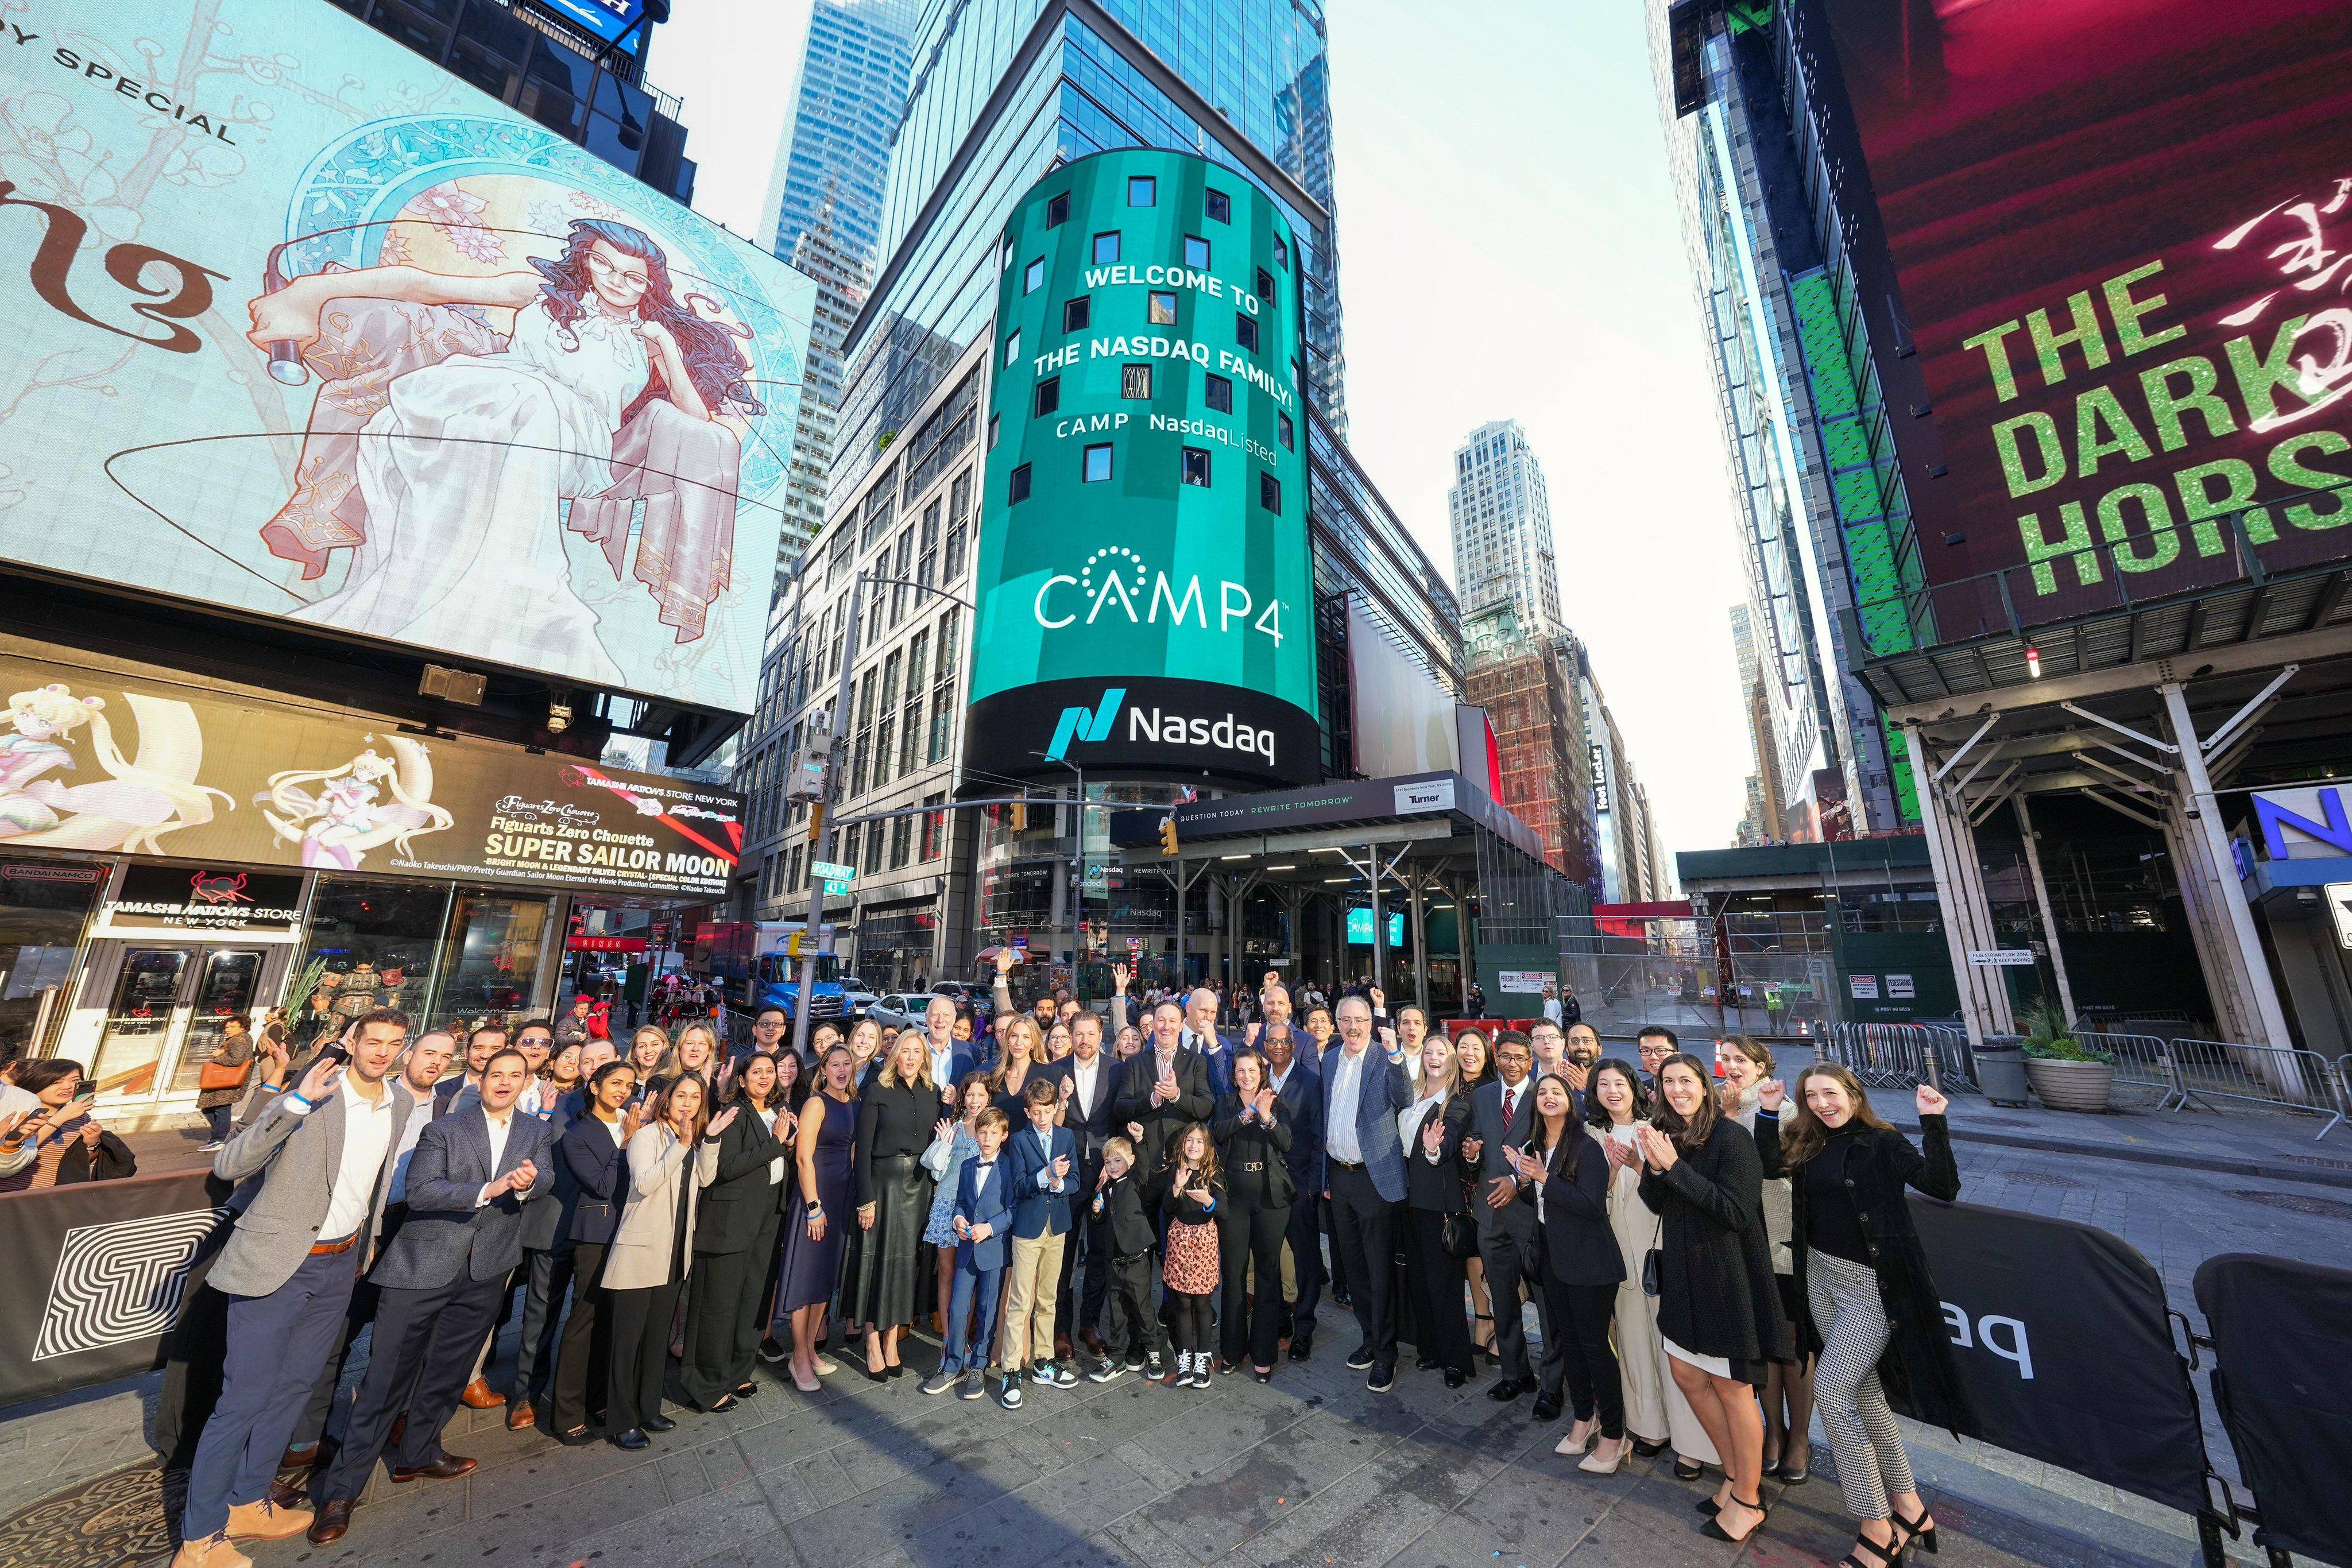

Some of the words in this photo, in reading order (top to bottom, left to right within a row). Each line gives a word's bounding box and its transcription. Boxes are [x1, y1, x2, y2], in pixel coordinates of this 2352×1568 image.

[53, 48, 236, 146] SPECIAL
[1085, 265, 1223, 297] WELCOME
[1231, 284, 1259, 315] TO
[1963, 259, 2187, 403] THE
[1034, 343, 1080, 377] THE
[1090, 336, 1209, 368] NASDAQ
[1219, 350, 1292, 413] FAMILY!
[1991, 313, 2335, 499] DARK
[1056, 413, 1129, 438] CAMP
[1129, 707, 1274, 766] Nasdaq
[666, 790, 693, 801] STORE
[695, 795, 714, 803] NEW
[715, 797, 738, 807] YORK
[1409, 795, 1440, 804] Turner
[1596, 785, 1608, 810] Foot
[1181, 811, 1216, 822] QUESTION
[1220, 809, 1244, 818] TODAY
[1251, 804, 1291, 814] REWRITE
[490, 816, 554, 835] Figuarts
[556, 824, 589, 839] Zero
[592, 829, 654, 847] Chouette
[484, 834, 572, 862] SUPER
[577, 843, 661, 870] SAILOR
[666, 853, 730, 877] MOON
[496, 869, 526, 878] Guardian
[527, 871, 546, 879] Sailor
[546, 873, 564, 881] Moon
[565, 874, 587, 883] Eternal
[598, 877, 617, 886] Movie
[618, 879, 648, 888] Production
[649, 882, 679, 891] Committee
[703, 886, 725, 895] Takeuchi
[517, 861, 543, 869] MOON
[550, 863, 592, 874] LEGENDARY
[593, 868, 616, 877] SILVER
[679, 876, 700, 884] COLOR
[1100, 866, 1123, 874] Nasdaq
[826, 882, 837, 893] 43
[163, 917, 199, 925] NEW
[206, 919, 247, 927] YORK
[253, 908, 301, 922] STORE
[1130, 909, 1161, 917] Nasdaq
[582, 939, 621, 948] DINER
